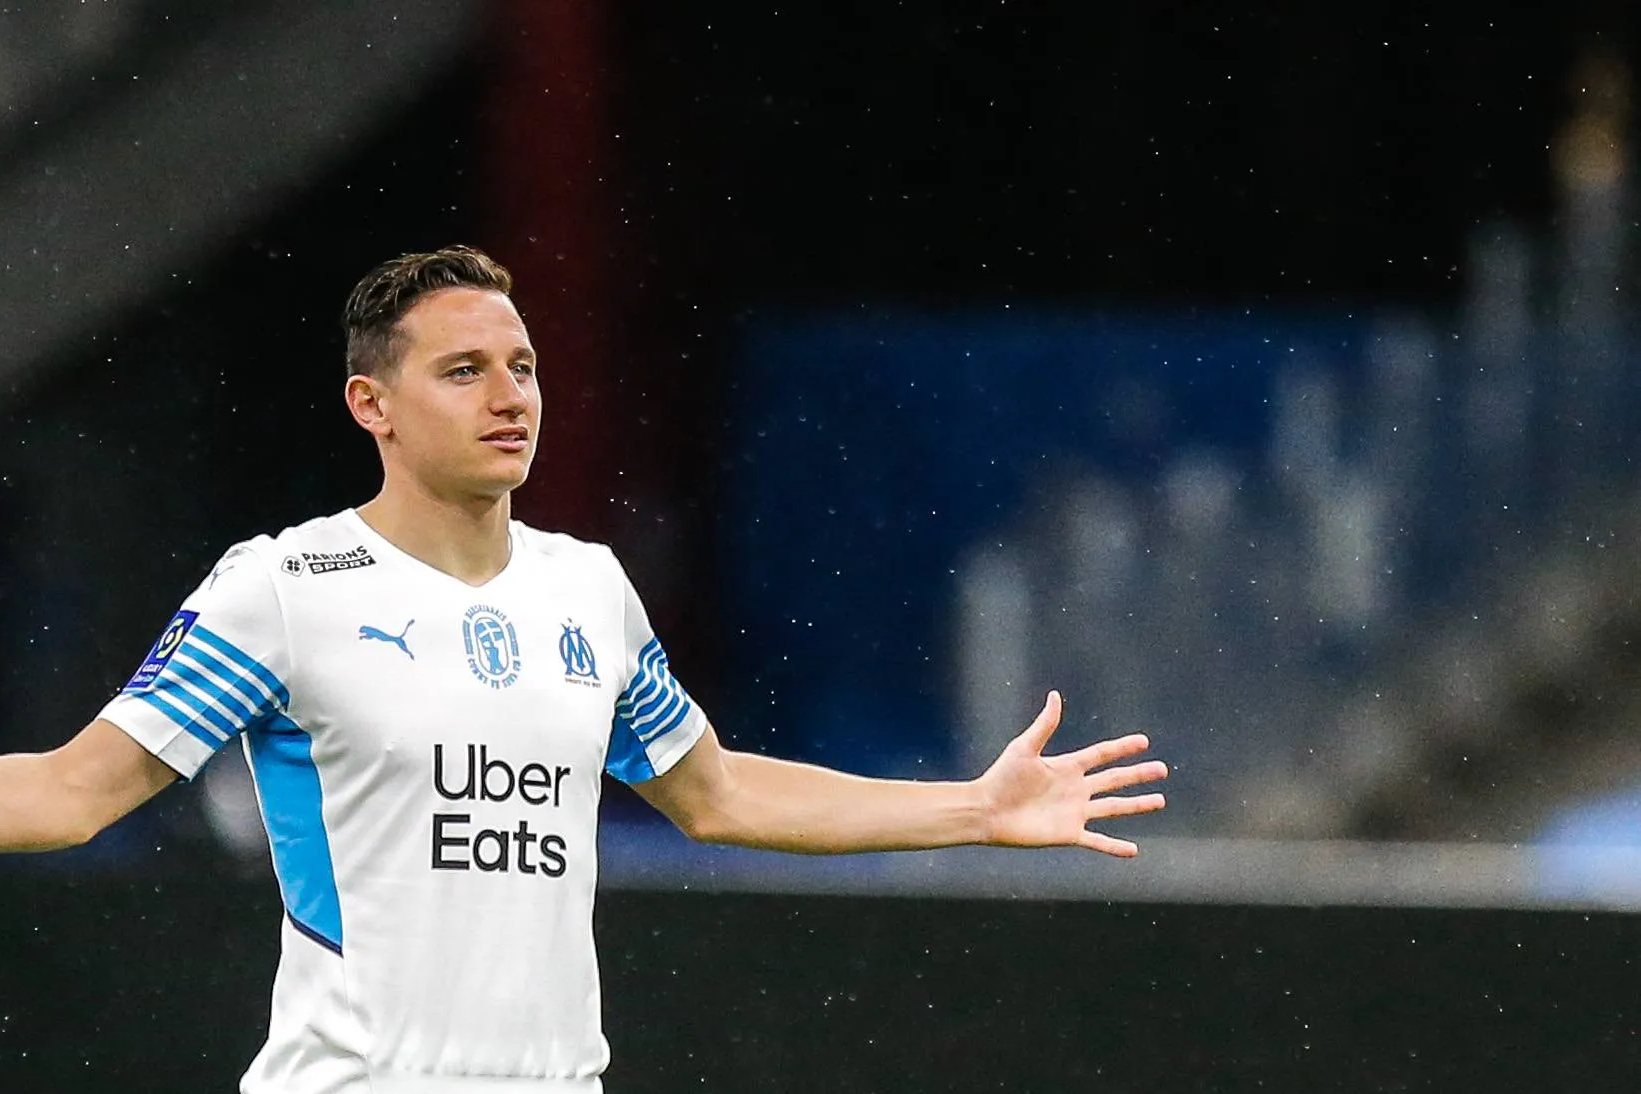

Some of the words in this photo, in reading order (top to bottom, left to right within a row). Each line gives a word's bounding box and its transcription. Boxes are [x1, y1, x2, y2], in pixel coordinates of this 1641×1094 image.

[301, 545, 368, 562] PARIONS
[310, 557, 372, 573] SPORT
[434, 743, 571, 807] Uber
[431, 813, 567, 878] Eats
